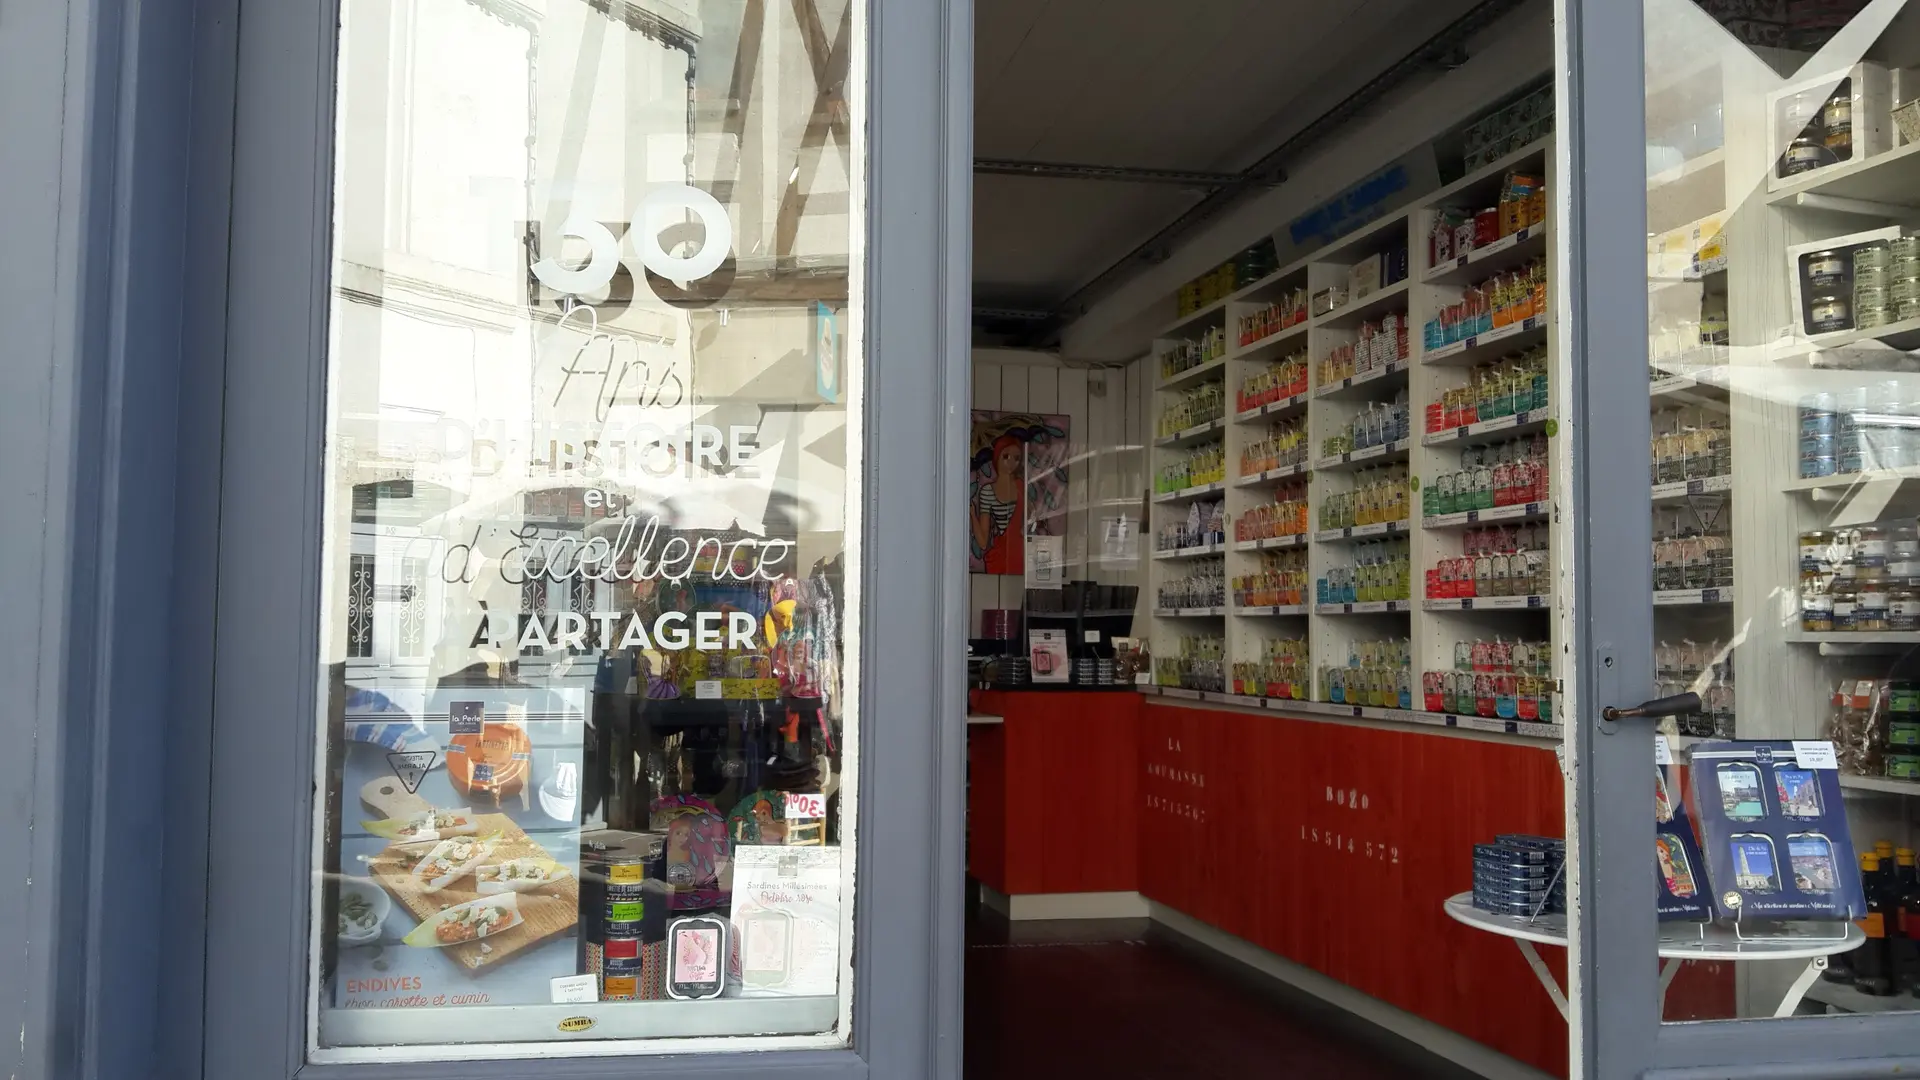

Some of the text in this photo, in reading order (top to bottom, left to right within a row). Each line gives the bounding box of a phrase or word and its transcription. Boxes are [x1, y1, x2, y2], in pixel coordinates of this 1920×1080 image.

[583, 488, 616, 508] et
[488, 611, 757, 650] PARTAGER
[747, 881, 780, 890] Sardines
[346, 976, 422, 993] ENDIVES
[432, 993, 447, 1006] et
[451, 991, 491, 1005] cumin
